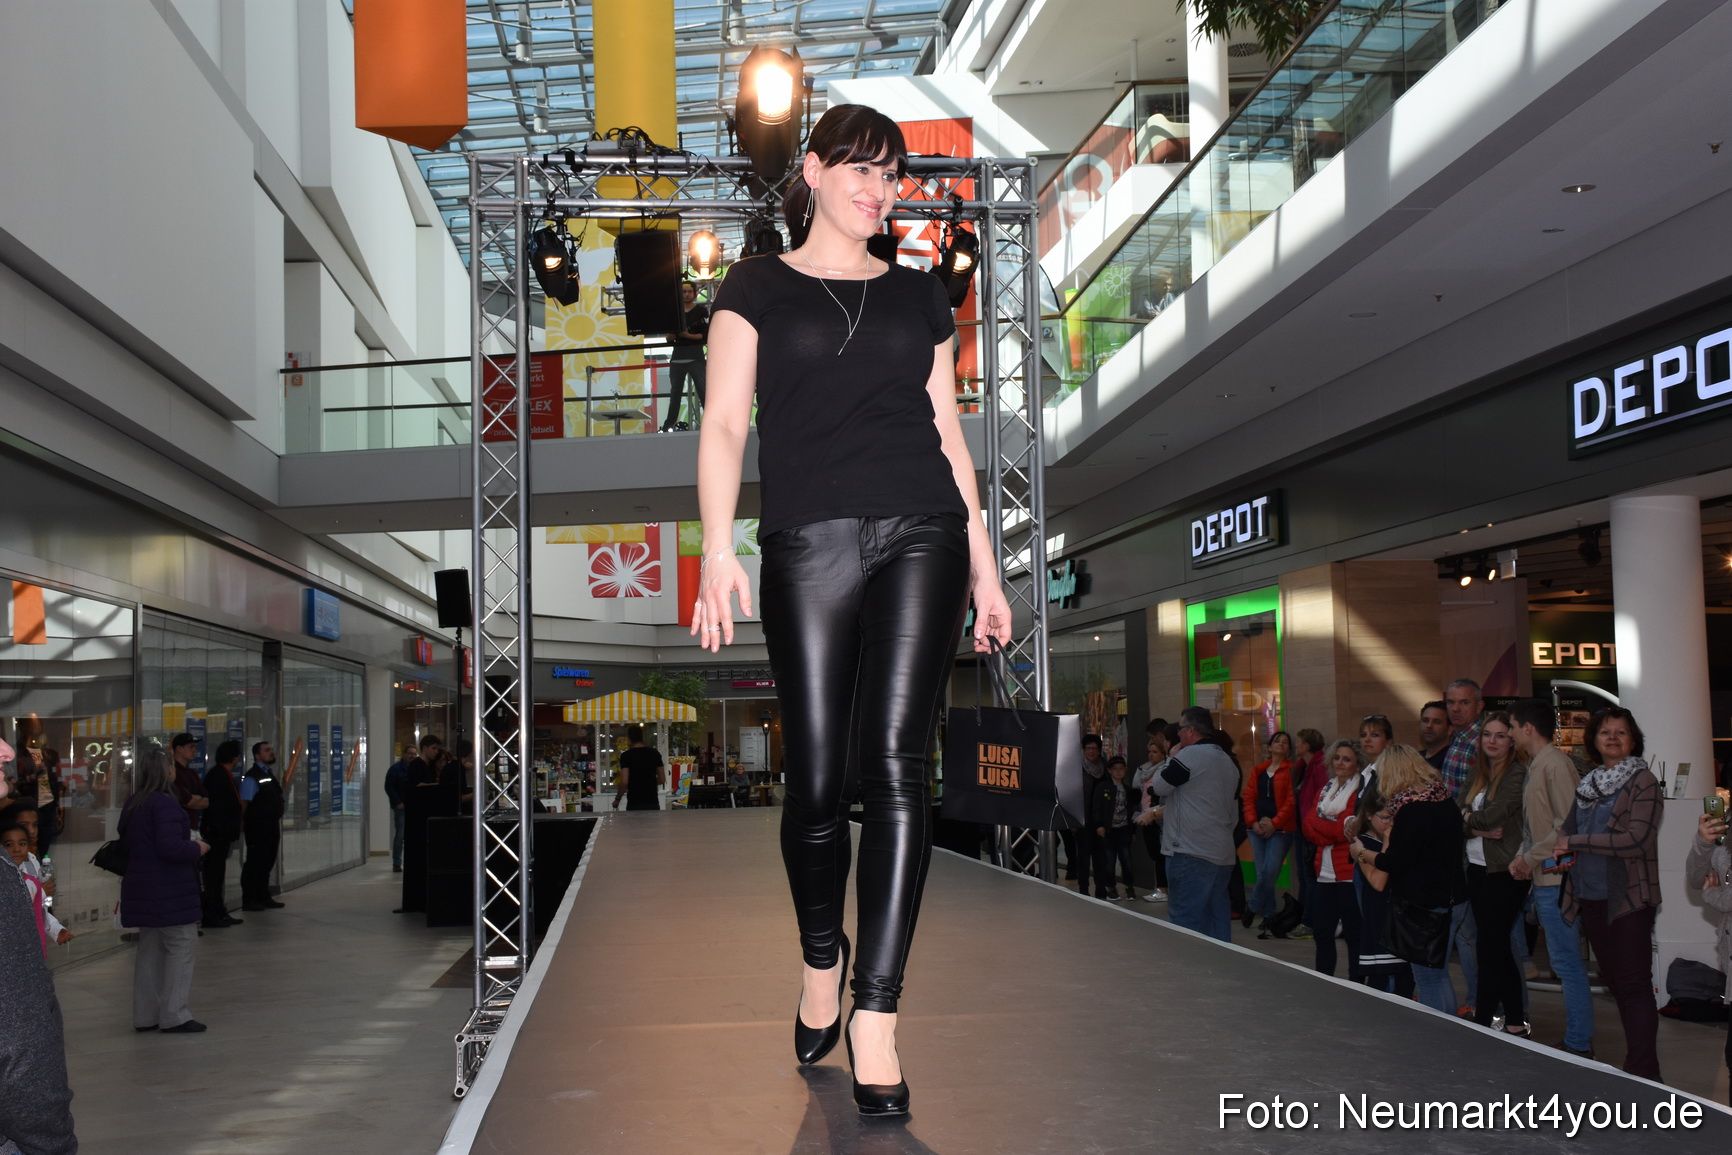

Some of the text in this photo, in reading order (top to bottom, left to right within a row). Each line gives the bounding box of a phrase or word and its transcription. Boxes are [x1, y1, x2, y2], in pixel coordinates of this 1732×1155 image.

[489, 399, 553, 414] CINELEX
[1191, 495, 1268, 557] DEPOT
[979, 744, 1020, 766] LUISA
[978, 766, 1020, 788] LUISA
